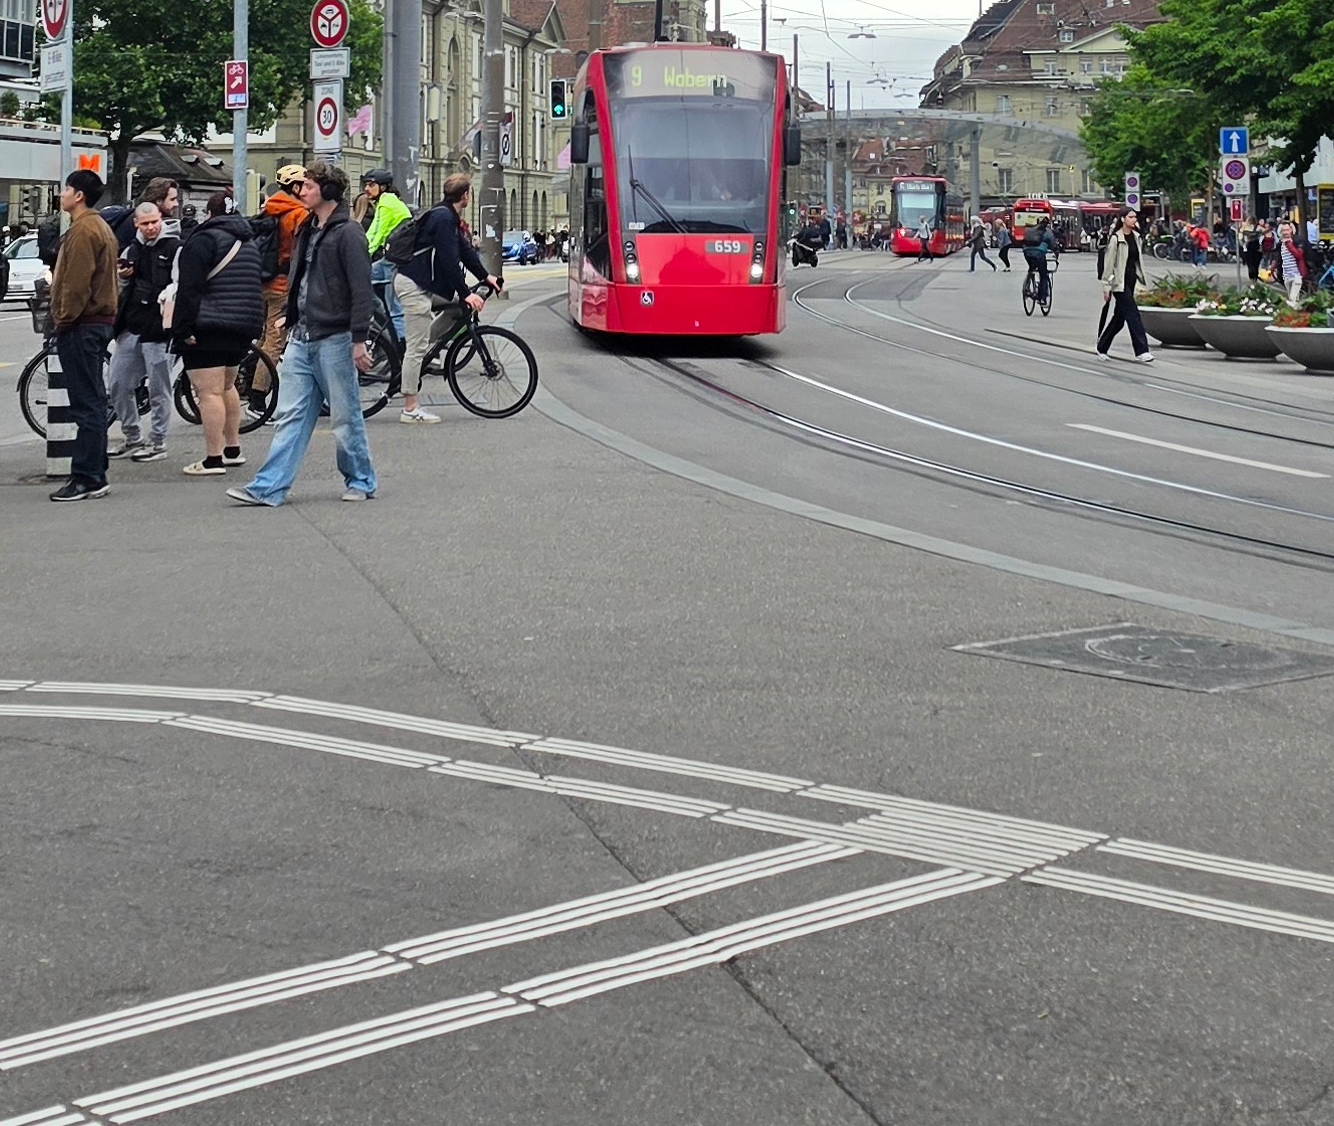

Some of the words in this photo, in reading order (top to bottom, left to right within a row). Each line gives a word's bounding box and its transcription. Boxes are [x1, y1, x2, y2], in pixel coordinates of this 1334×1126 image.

[631, 65, 642, 87] 9
[664, 66, 727, 88] Wabern
[322, 110, 332, 125] 30
[78, 153, 100, 173] M
[714, 239, 742, 254] 659
